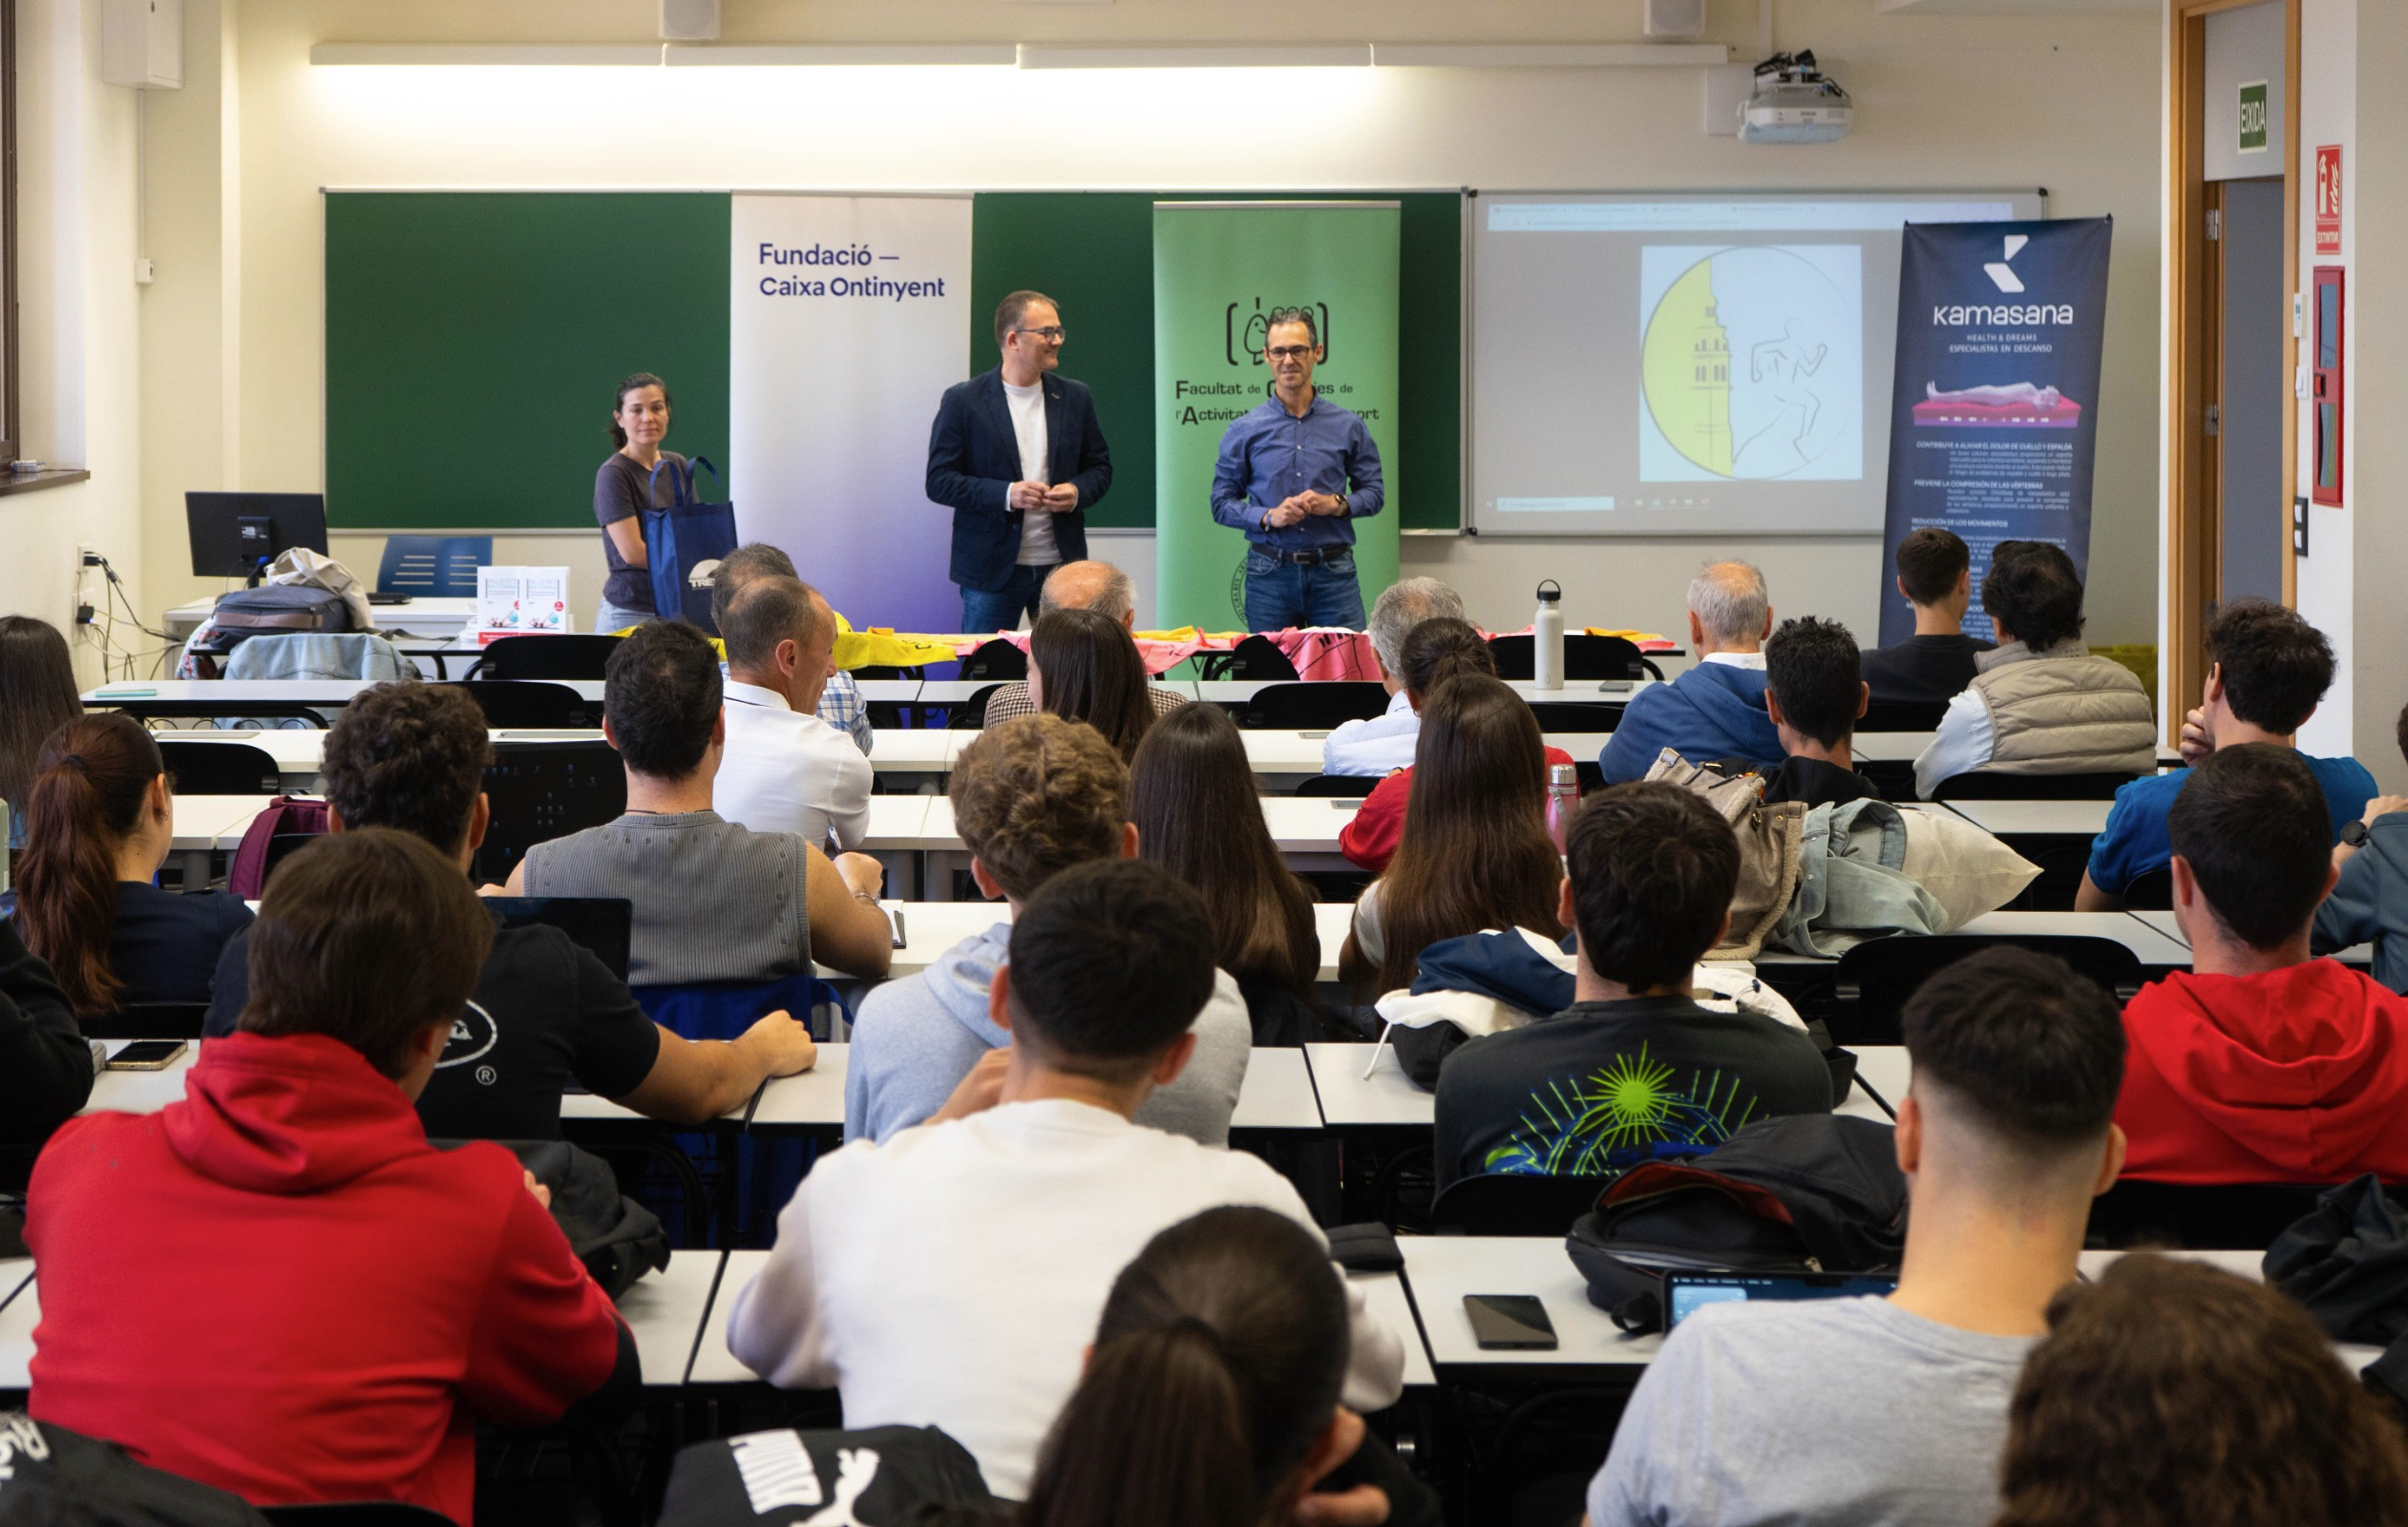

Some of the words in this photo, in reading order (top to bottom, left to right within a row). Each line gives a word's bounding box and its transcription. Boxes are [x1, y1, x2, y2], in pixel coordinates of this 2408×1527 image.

[2241, 100, 2266, 134] EIXIDA
[2316, 231, 2339, 244] EXTINTOR
[759, 243, 873, 265] Fundació
[759, 275, 825, 296] Caixa
[830, 276, 945, 302] Ontinyent
[1967, 332, 1996, 342] HEALTH
[2005, 333, 2038, 342] DREAMS
[2000, 344, 2011, 352] EN
[2014, 344, 2053, 352] DESCANSO
[1176, 380, 1242, 399] Facultat
[1247, 384, 1260, 394] de
[1340, 384, 1354, 393] de
